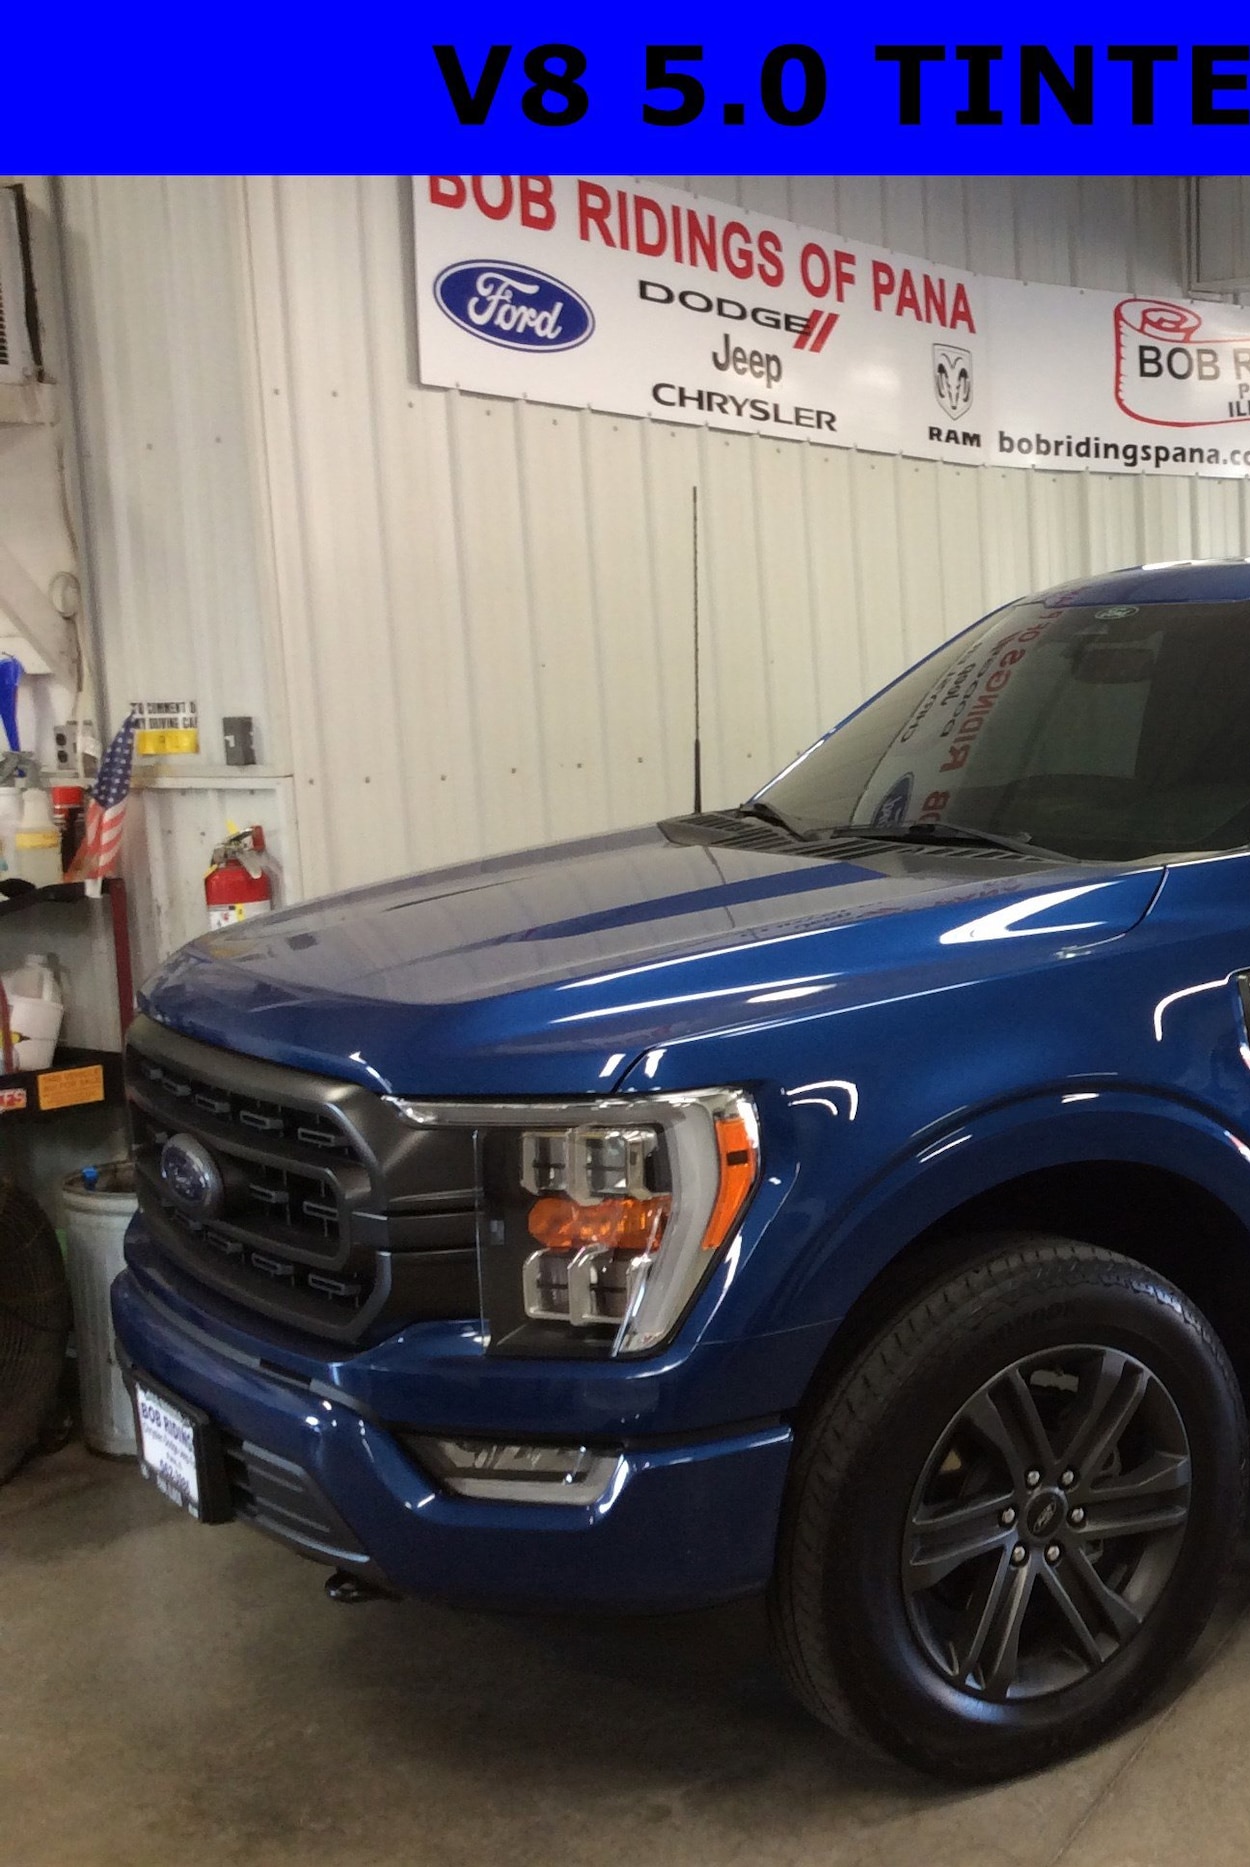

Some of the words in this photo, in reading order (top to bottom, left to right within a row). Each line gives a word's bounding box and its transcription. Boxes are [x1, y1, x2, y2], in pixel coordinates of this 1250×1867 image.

[576, 179, 783, 288] RIDINGS
[800, 241, 856, 302] OF
[872, 259, 976, 333] PANA
[466, 271, 563, 341] Ford
[638, 279, 812, 336] DODGE
[711, 333, 783, 388] Jeep
[1138, 345, 1220, 381] BOB
[652, 382, 837, 432] CHRYSLER
[928, 425, 982, 448] RAM
[142, 1402, 162, 1428] BOB
